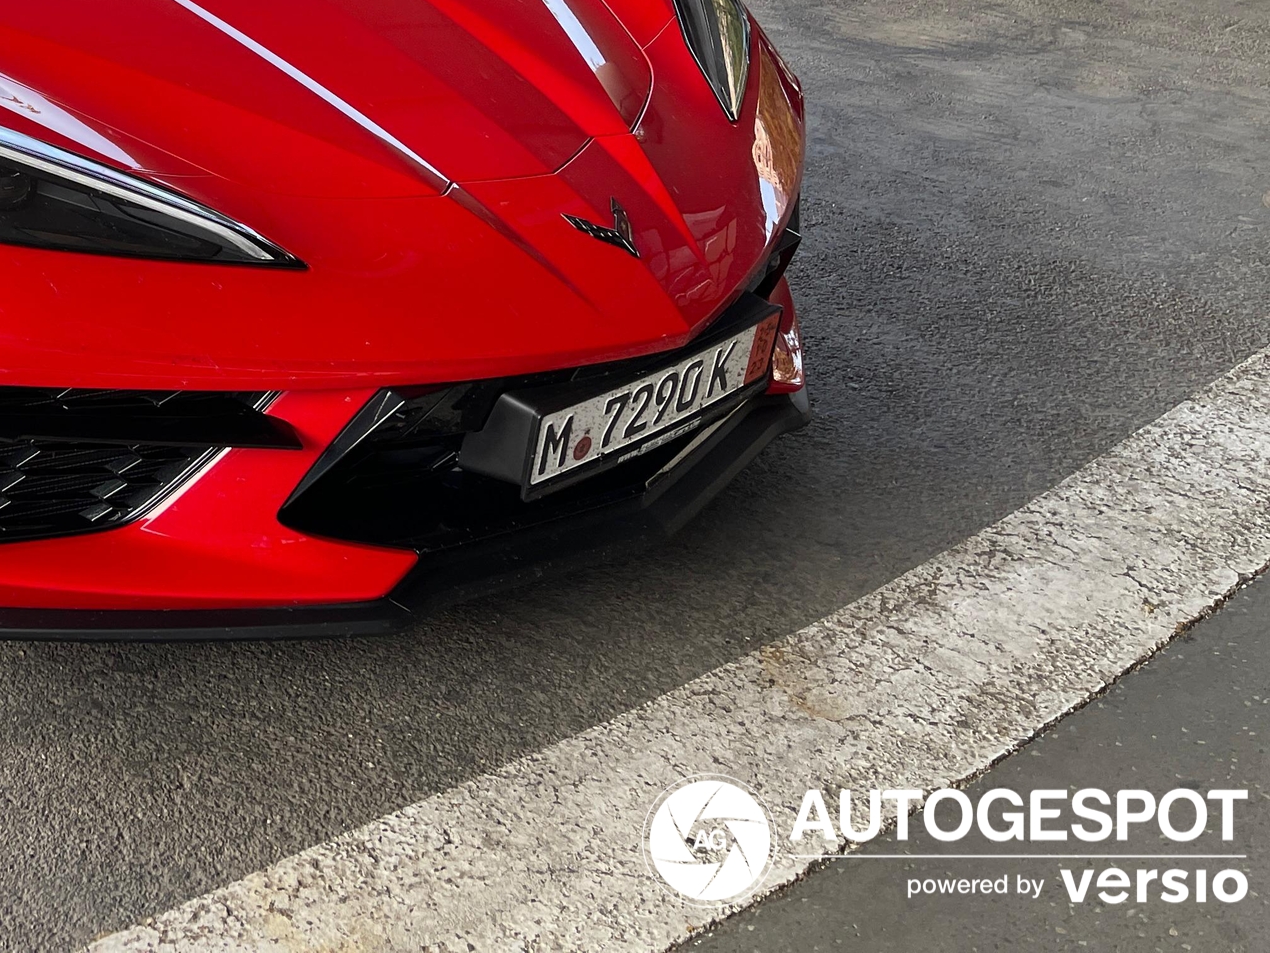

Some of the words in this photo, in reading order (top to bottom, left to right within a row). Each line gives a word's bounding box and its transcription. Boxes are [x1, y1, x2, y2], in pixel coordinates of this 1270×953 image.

[538, 414, 574, 475] M
[600, 359, 704, 449] 7290
[705, 340, 738, 398] K
